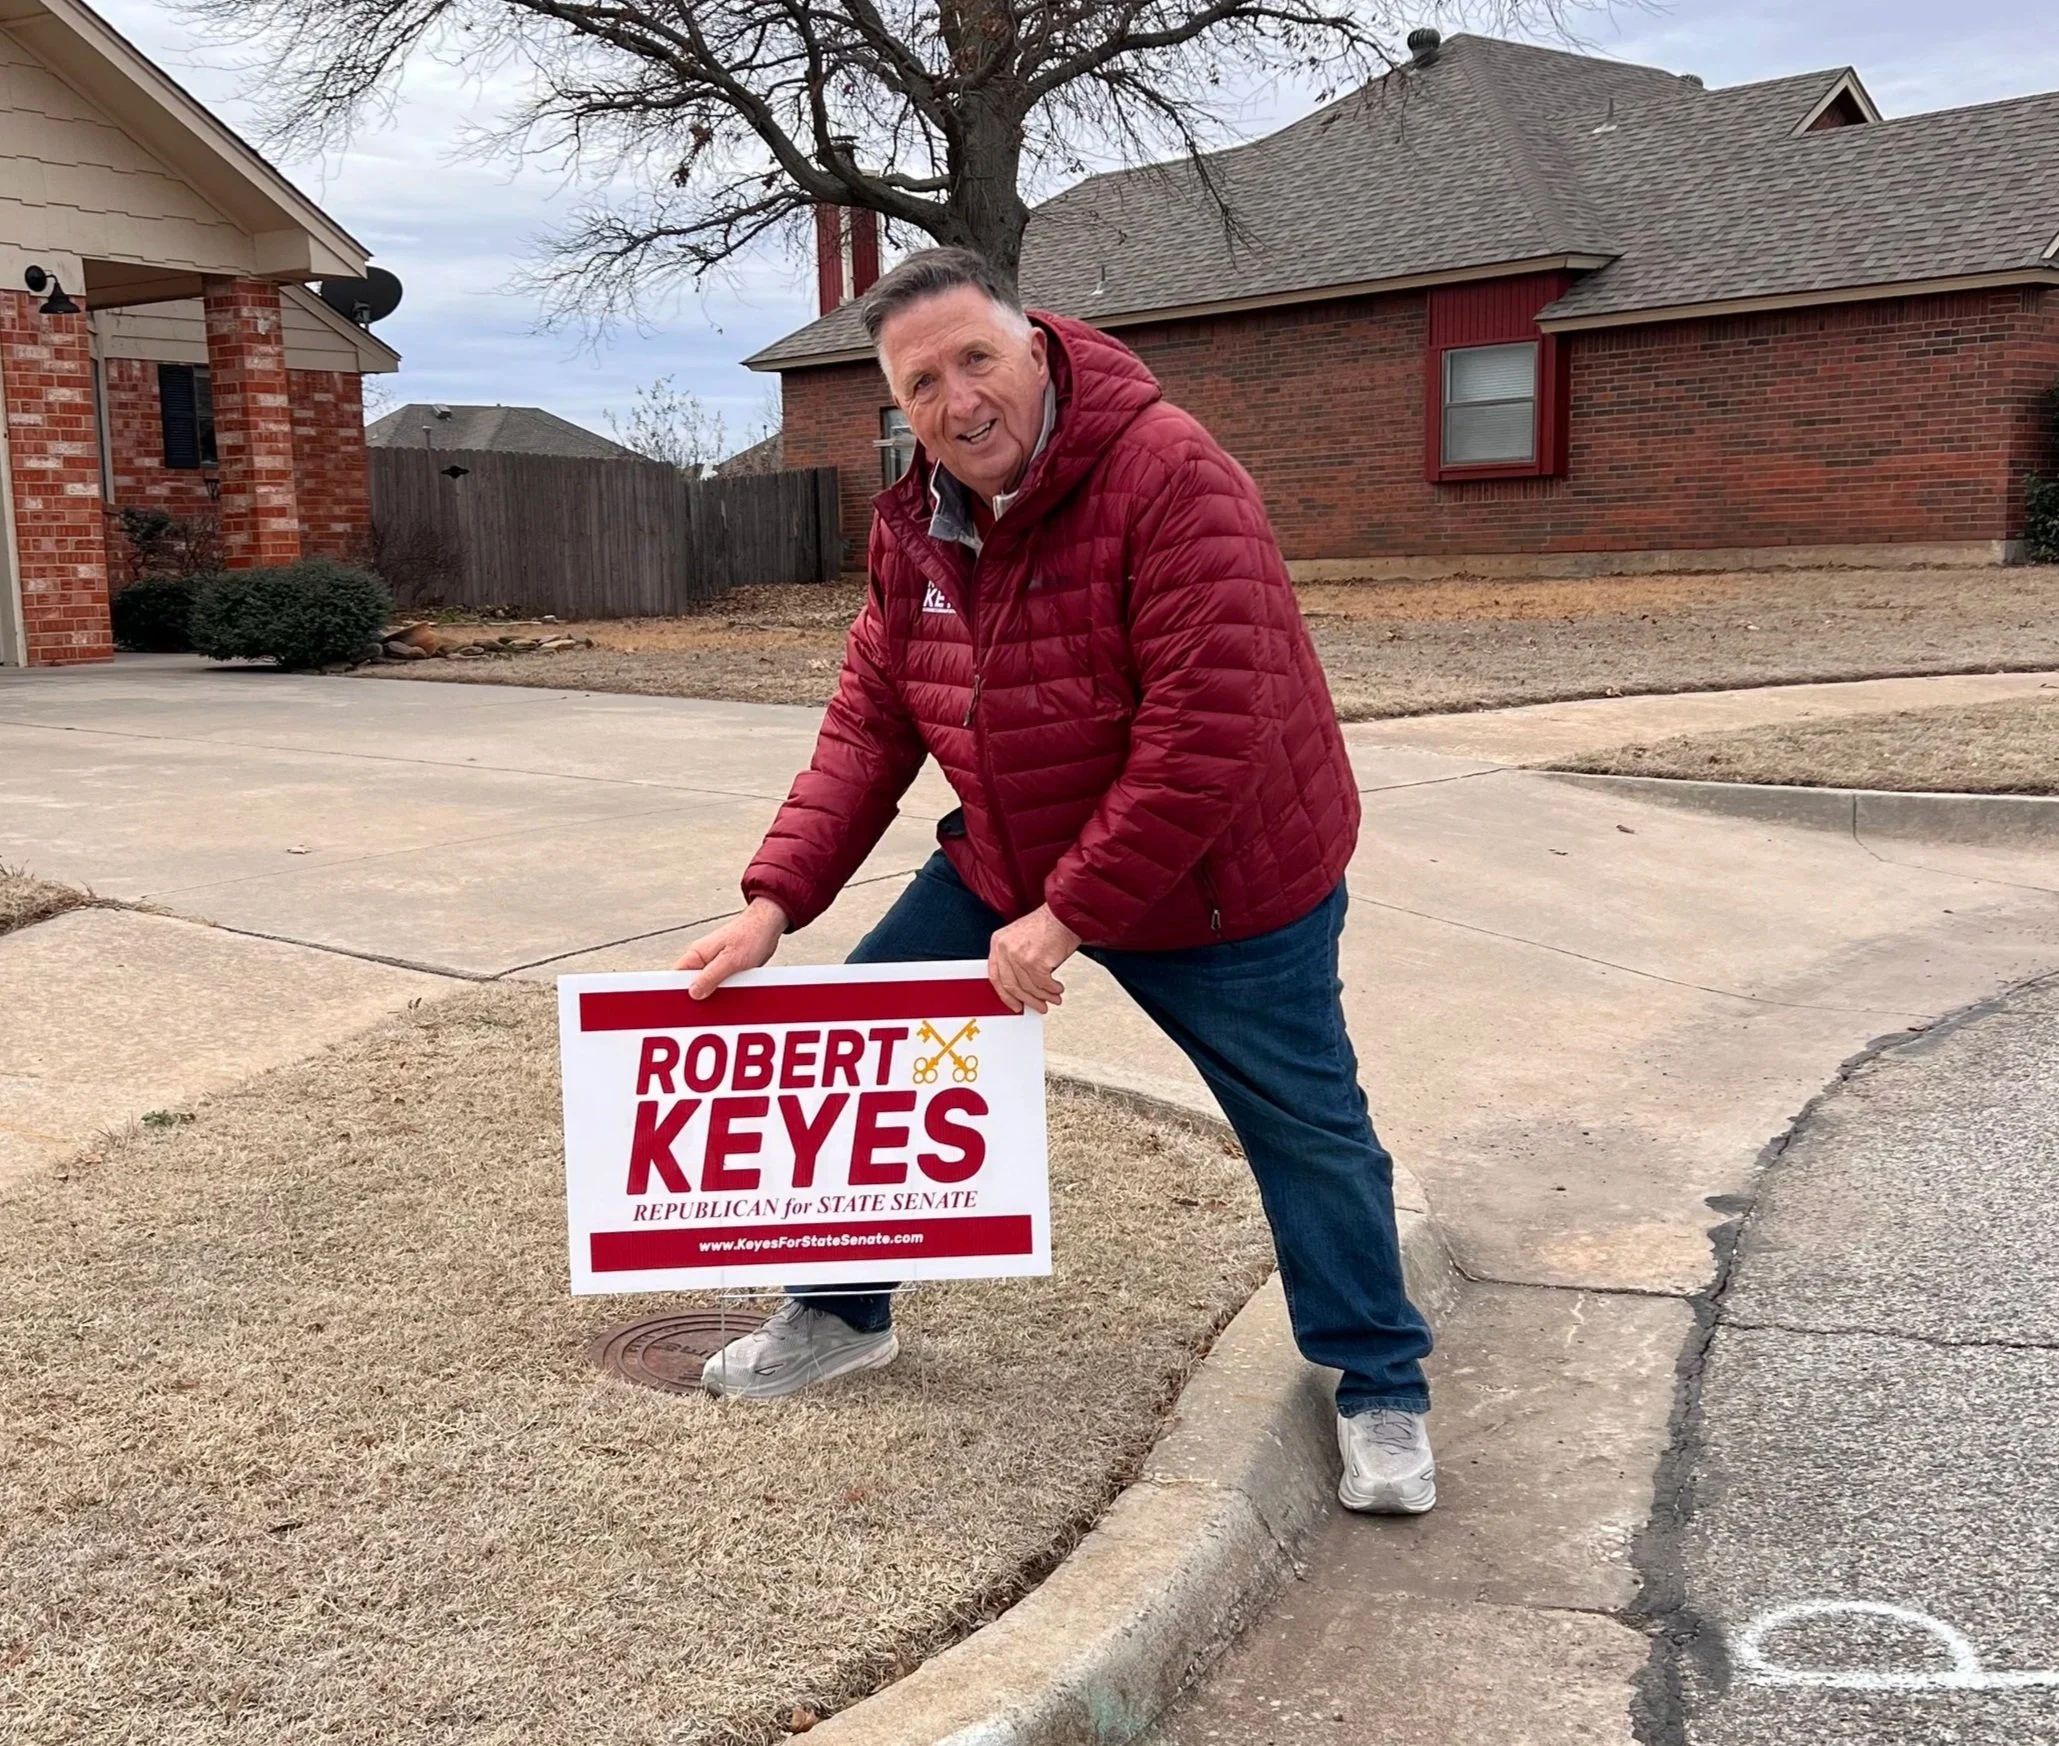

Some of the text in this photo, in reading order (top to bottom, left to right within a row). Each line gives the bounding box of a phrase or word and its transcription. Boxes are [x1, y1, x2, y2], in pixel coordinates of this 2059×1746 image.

[923, 588, 951, 608] KE
[635, 1026, 909, 1096] ROBERT
[626, 1087, 989, 1196] KEYES
[632, 1190, 979, 1222] REPUBLICAN for STATE SENATE
[698, 1232, 924, 1253] www.KeyesForStateSenate.com
